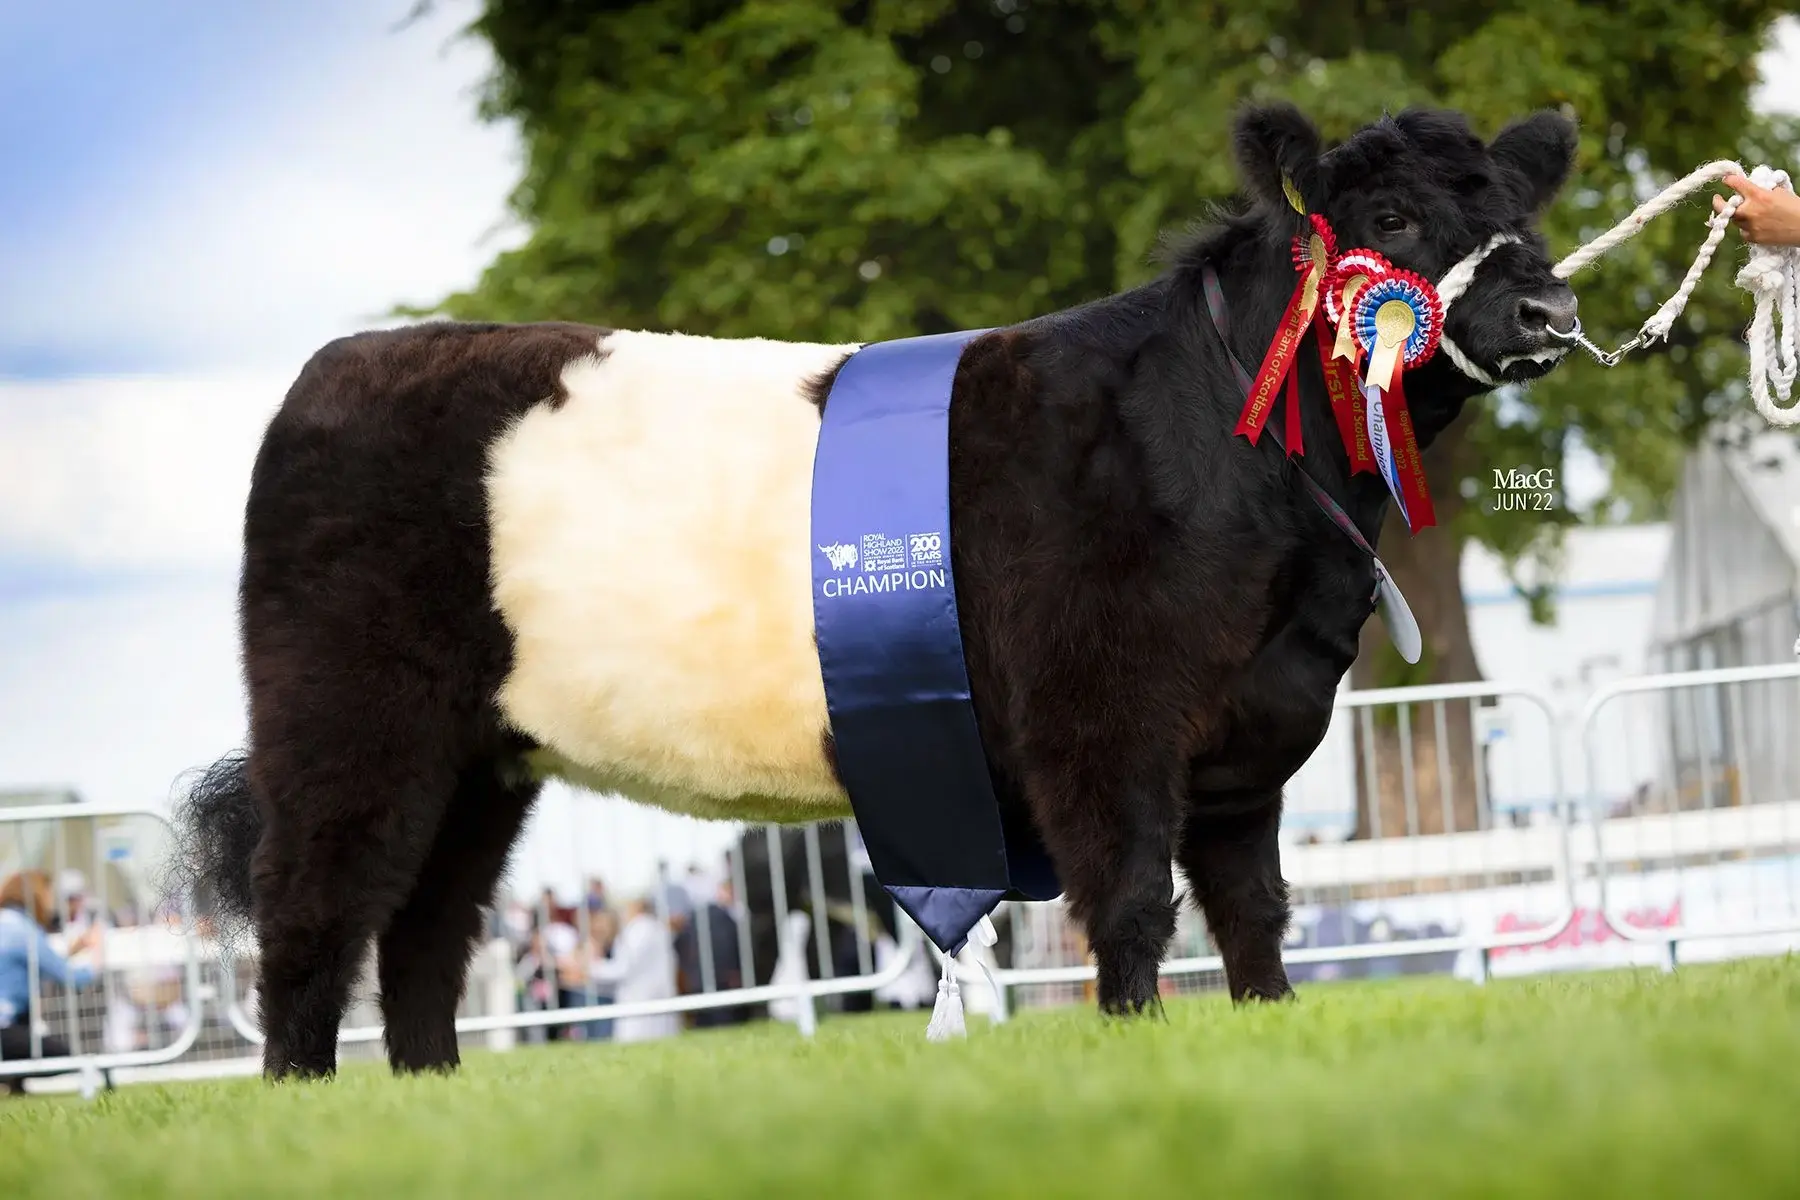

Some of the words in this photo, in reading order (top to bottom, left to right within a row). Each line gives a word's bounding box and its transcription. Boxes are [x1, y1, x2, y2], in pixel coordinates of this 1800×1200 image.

[1279, 328, 1296, 359] Bank
[1271, 360, 1281, 376] of
[1246, 374, 1276, 428] Scotland
[1352, 401, 1365, 413] of
[1400, 410, 1412, 437] Royal
[1354, 415, 1368, 460] Scotland
[1373, 402, 1388, 477] Champion
[1395, 448, 1408, 471] 2022
[1405, 436, 1421, 475] Highland
[863, 533, 886, 541] ROYAL
[863, 539, 902, 549] HIGHLAND
[910, 535, 941, 552] 200
[863, 548, 887, 556] SHOW
[888, 546, 904, 554] 2022
[911, 550, 942, 560] YEARS
[823, 569, 945, 597] CHAMPION
